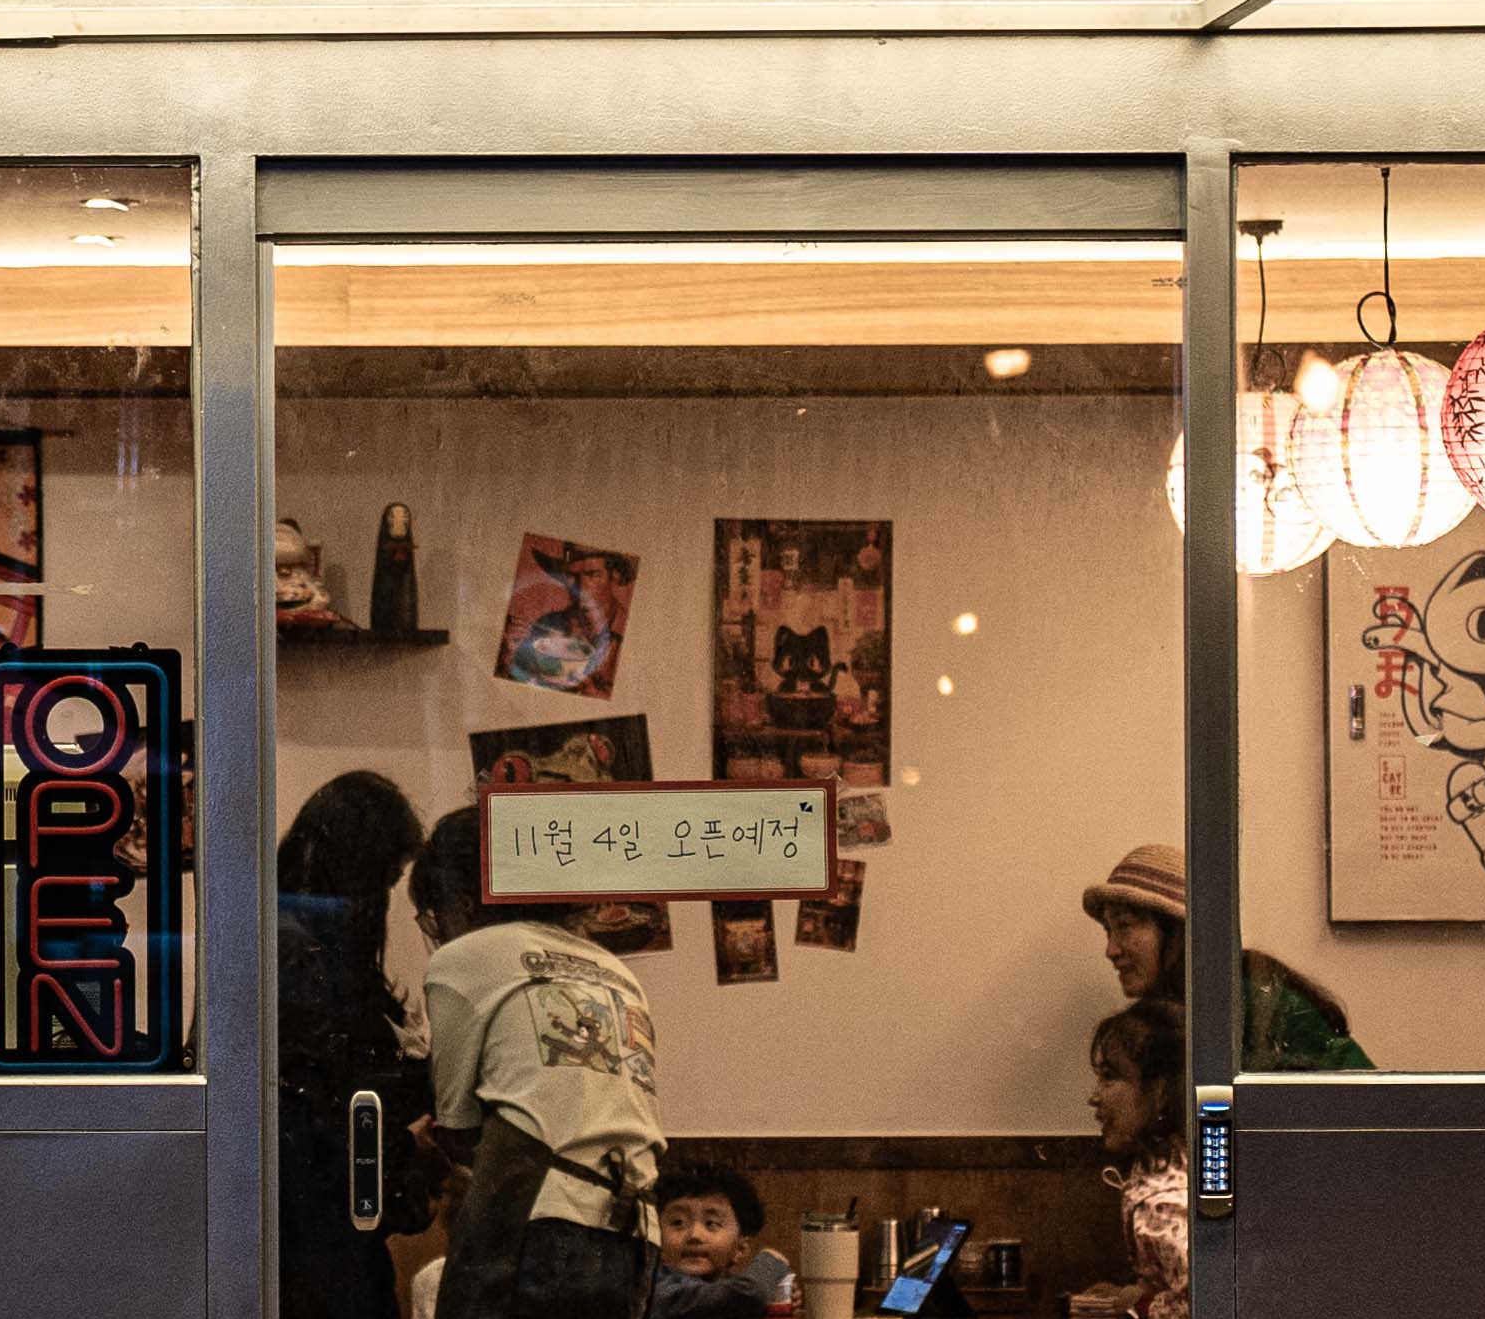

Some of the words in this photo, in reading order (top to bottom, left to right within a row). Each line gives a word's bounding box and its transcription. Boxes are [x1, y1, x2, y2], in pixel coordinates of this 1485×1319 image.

[1373, 585, 1419, 700] BE
[23, 674, 127, 1057] OPEN
[515, 820, 576, 867] 11월
[592, 820, 644, 862] 4일
[666, 816, 800, 859] 오픈예정
